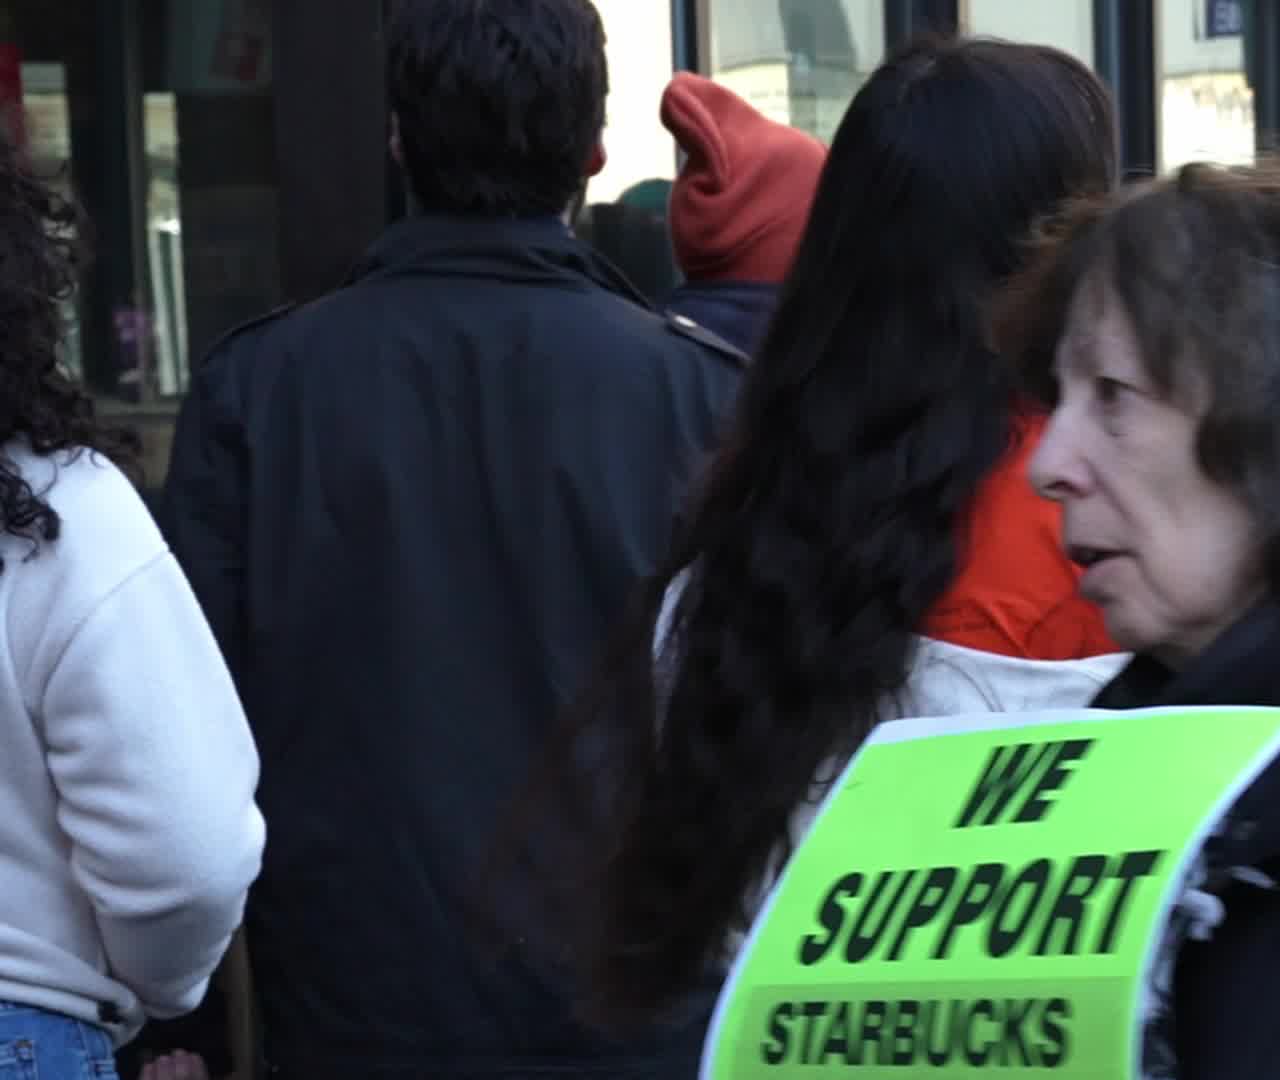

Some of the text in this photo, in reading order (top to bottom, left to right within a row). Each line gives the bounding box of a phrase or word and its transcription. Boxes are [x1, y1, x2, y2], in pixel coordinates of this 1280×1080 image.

[952, 738, 1099, 829] WE
[796, 849, 1170, 966] SUPPORT
[760, 997, 1074, 1068] STARBUCKS
